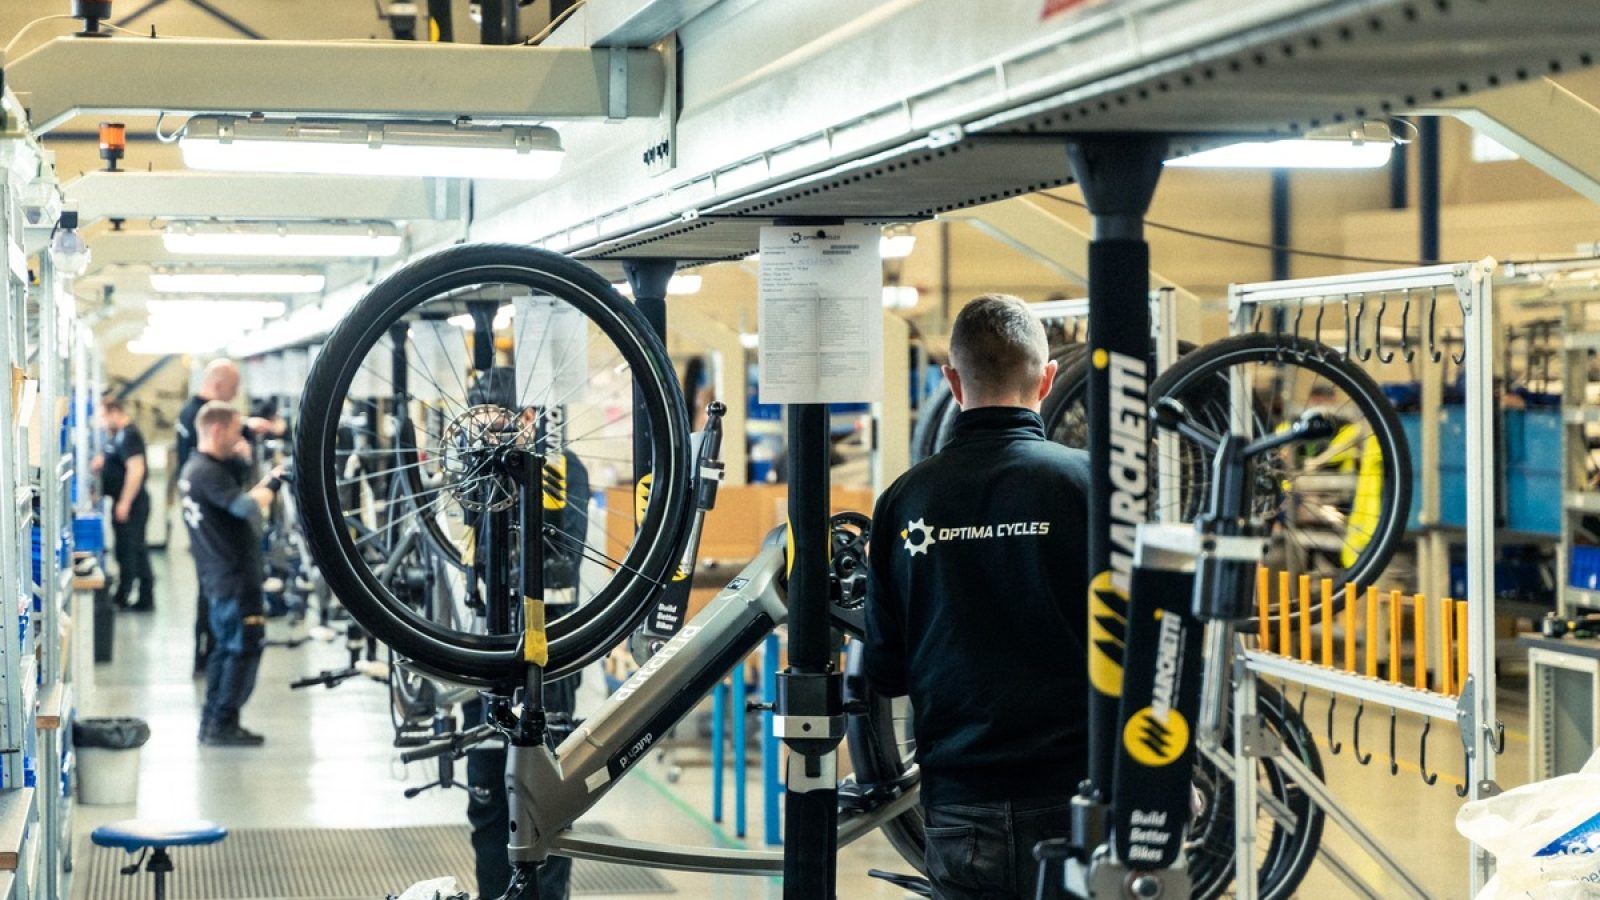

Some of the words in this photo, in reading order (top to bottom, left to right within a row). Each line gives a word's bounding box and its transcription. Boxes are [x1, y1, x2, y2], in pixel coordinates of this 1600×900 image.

[938, 525, 993, 541] OPTIMA
[996, 521, 1051, 537] CYCLES
[627, 732, 652, 758] dutch
[1131, 808, 1168, 826] Build
[1129, 827, 1171, 843] Better
[1128, 844, 1164, 862] Bikes
